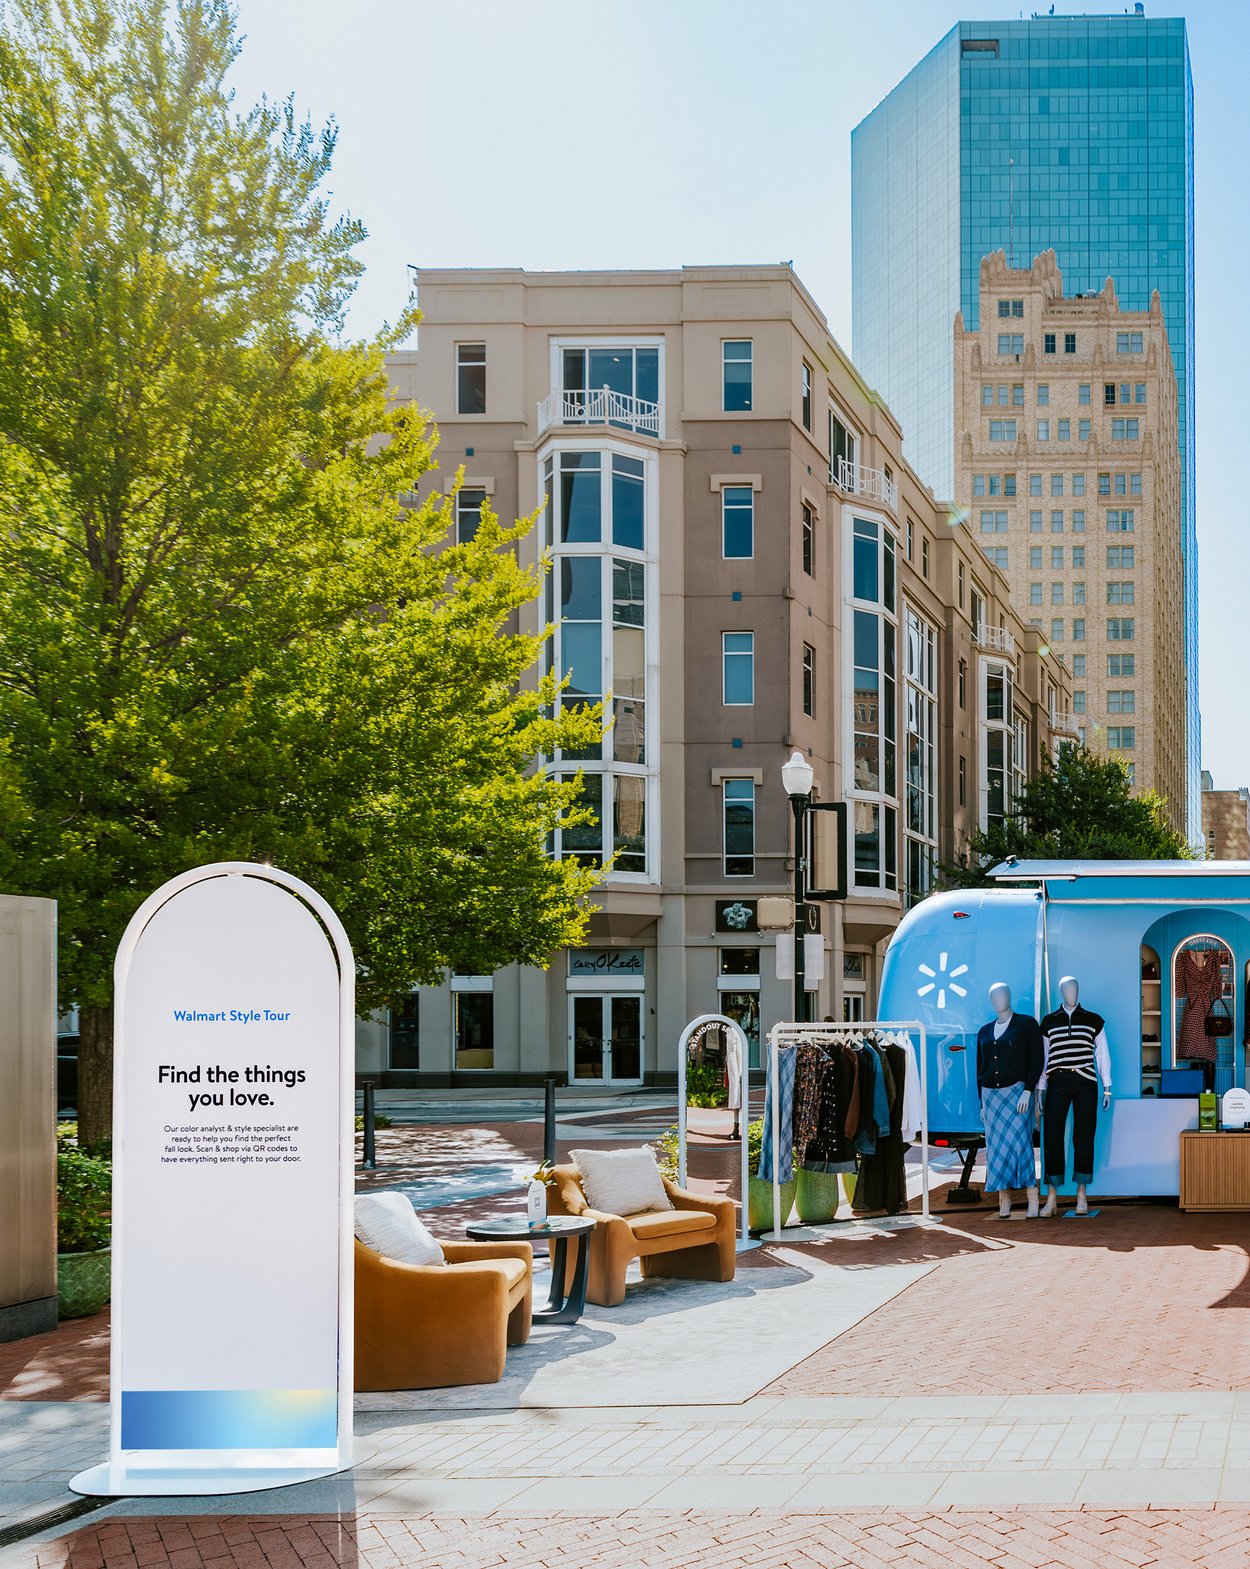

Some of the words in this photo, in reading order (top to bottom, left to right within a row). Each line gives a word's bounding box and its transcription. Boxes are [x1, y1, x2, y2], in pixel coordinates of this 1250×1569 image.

[173, 1010, 226, 1022] Walmart
[229, 1010, 261, 1024] Style
[263, 1010, 291, 1021] Tour
[692, 1023, 721, 1049] STANDOUT
[159, 1065, 201, 1083] Find
[206, 1065, 239, 1083] the
[244, 1065, 306, 1088] things
[189, 1094, 224, 1112] you
[230, 1088, 275, 1106] love.
[200, 1125, 225, 1133] analyst
[235, 1125, 252, 1133] style
[253, 1125, 286, 1133] specialist
[172, 1136, 191, 1144] ready
[203, 1135, 218, 1144] help
[220, 1136, 233, 1144] you
[264, 1135, 291, 1143] perfect
[222, 1145, 240, 1153] shop
[252, 1144, 265, 1152] QR
[179, 1155, 218, 1164] everything
[236, 1155, 254, 1164] right
[264, 1156, 281, 1164] your
